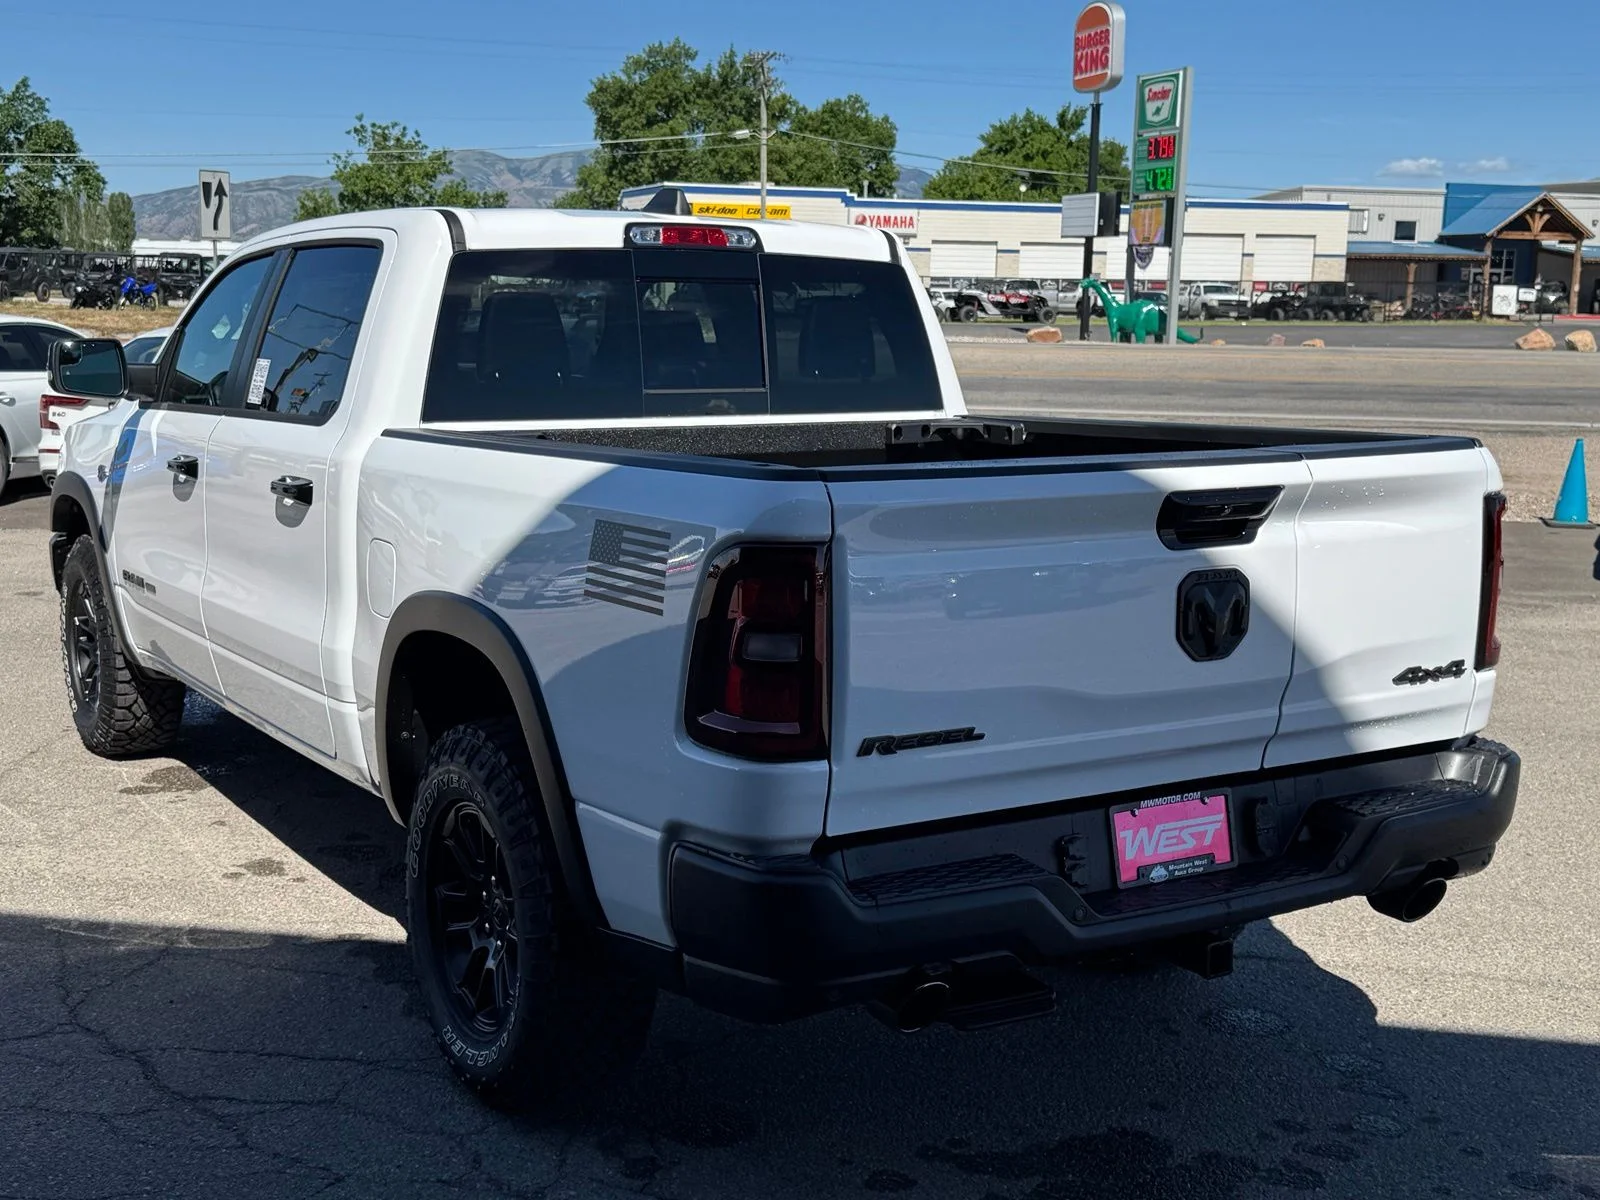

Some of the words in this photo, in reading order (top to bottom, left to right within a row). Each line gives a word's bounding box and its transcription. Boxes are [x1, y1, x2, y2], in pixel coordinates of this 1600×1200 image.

[1075, 28, 1110, 49] BURGER
[1074, 46, 1110, 76] KING
[697, 206, 738, 215] ski-doo
[868, 215, 914, 228] YAMAHA
[856, 726, 987, 757] REBEL
[1140, 791, 1201, 809] MWMOTOR.COM
[409, 773, 485, 878] GOODYEAR
[1119, 813, 1224, 861] WEST
[1168, 860, 1194, 871] Mountain
[1194, 858, 1208, 866] West
[1187, 867, 1204, 875] Group
